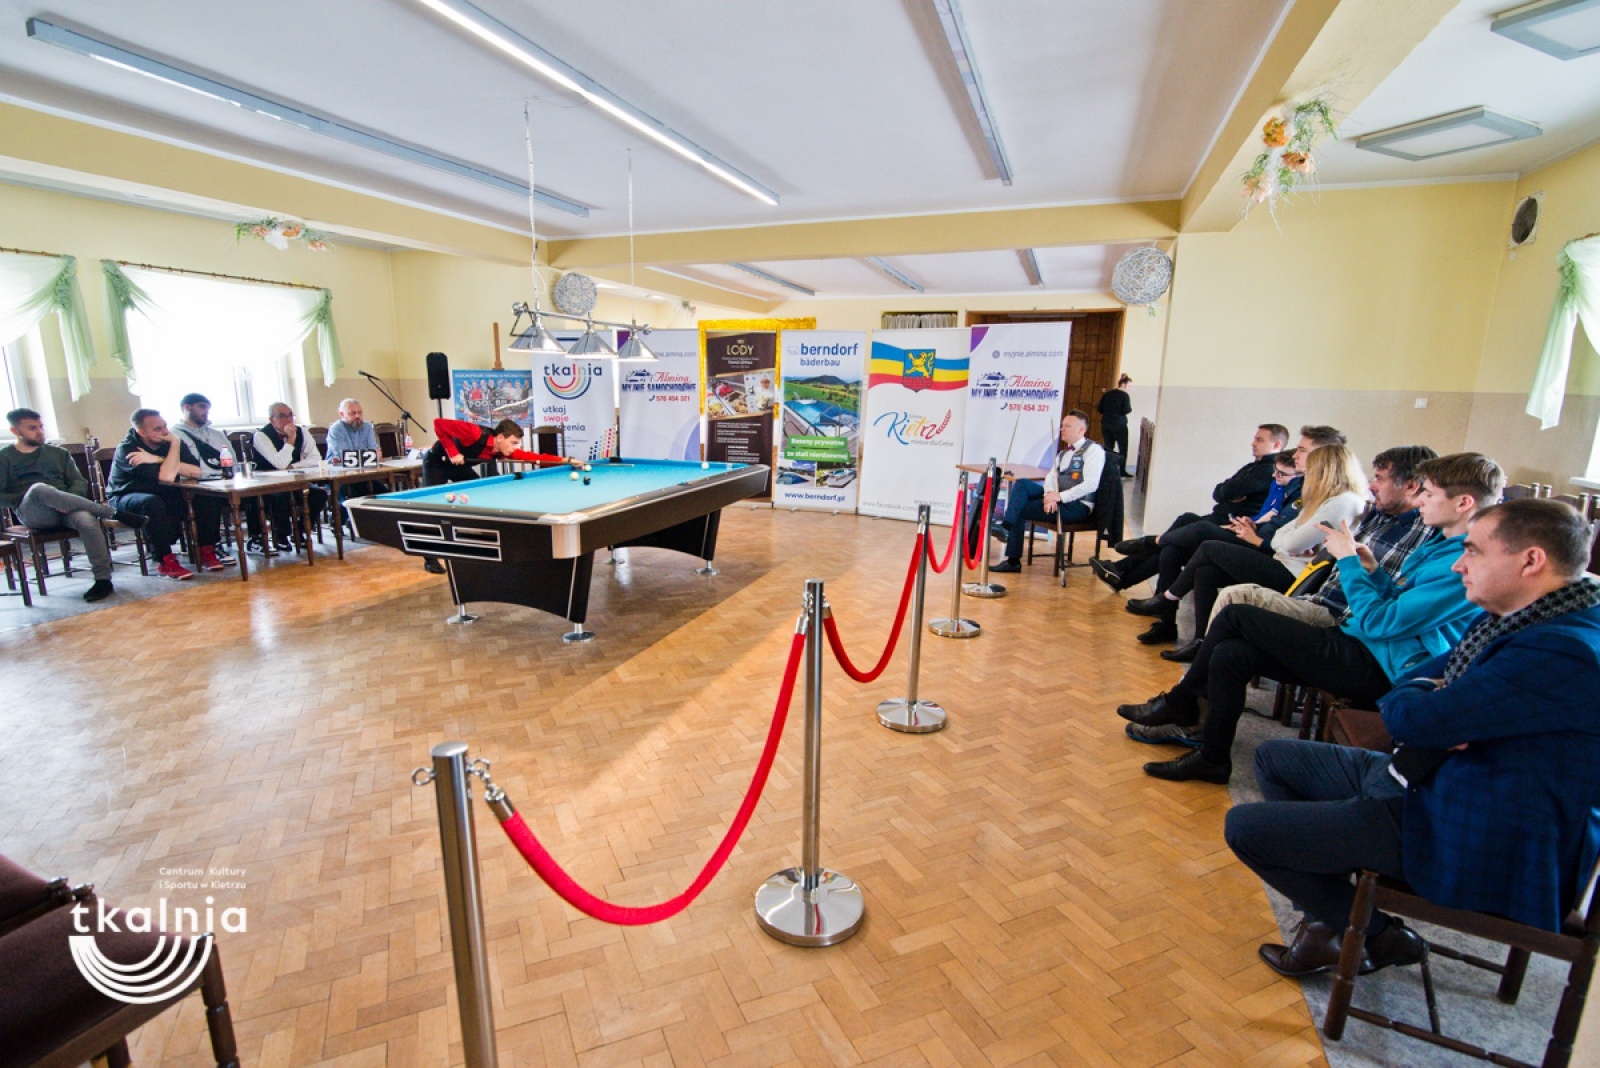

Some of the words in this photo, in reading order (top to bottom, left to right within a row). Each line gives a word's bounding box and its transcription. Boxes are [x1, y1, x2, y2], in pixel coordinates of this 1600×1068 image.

[726, 344, 754, 356] LODY
[801, 343, 858, 355] berndorf
[543, 363, 603, 376] tkalnia
[542, 405, 566, 414] utkaj
[543, 414, 569, 422] swoje
[784, 492, 846, 502] www.berndorf.pl
